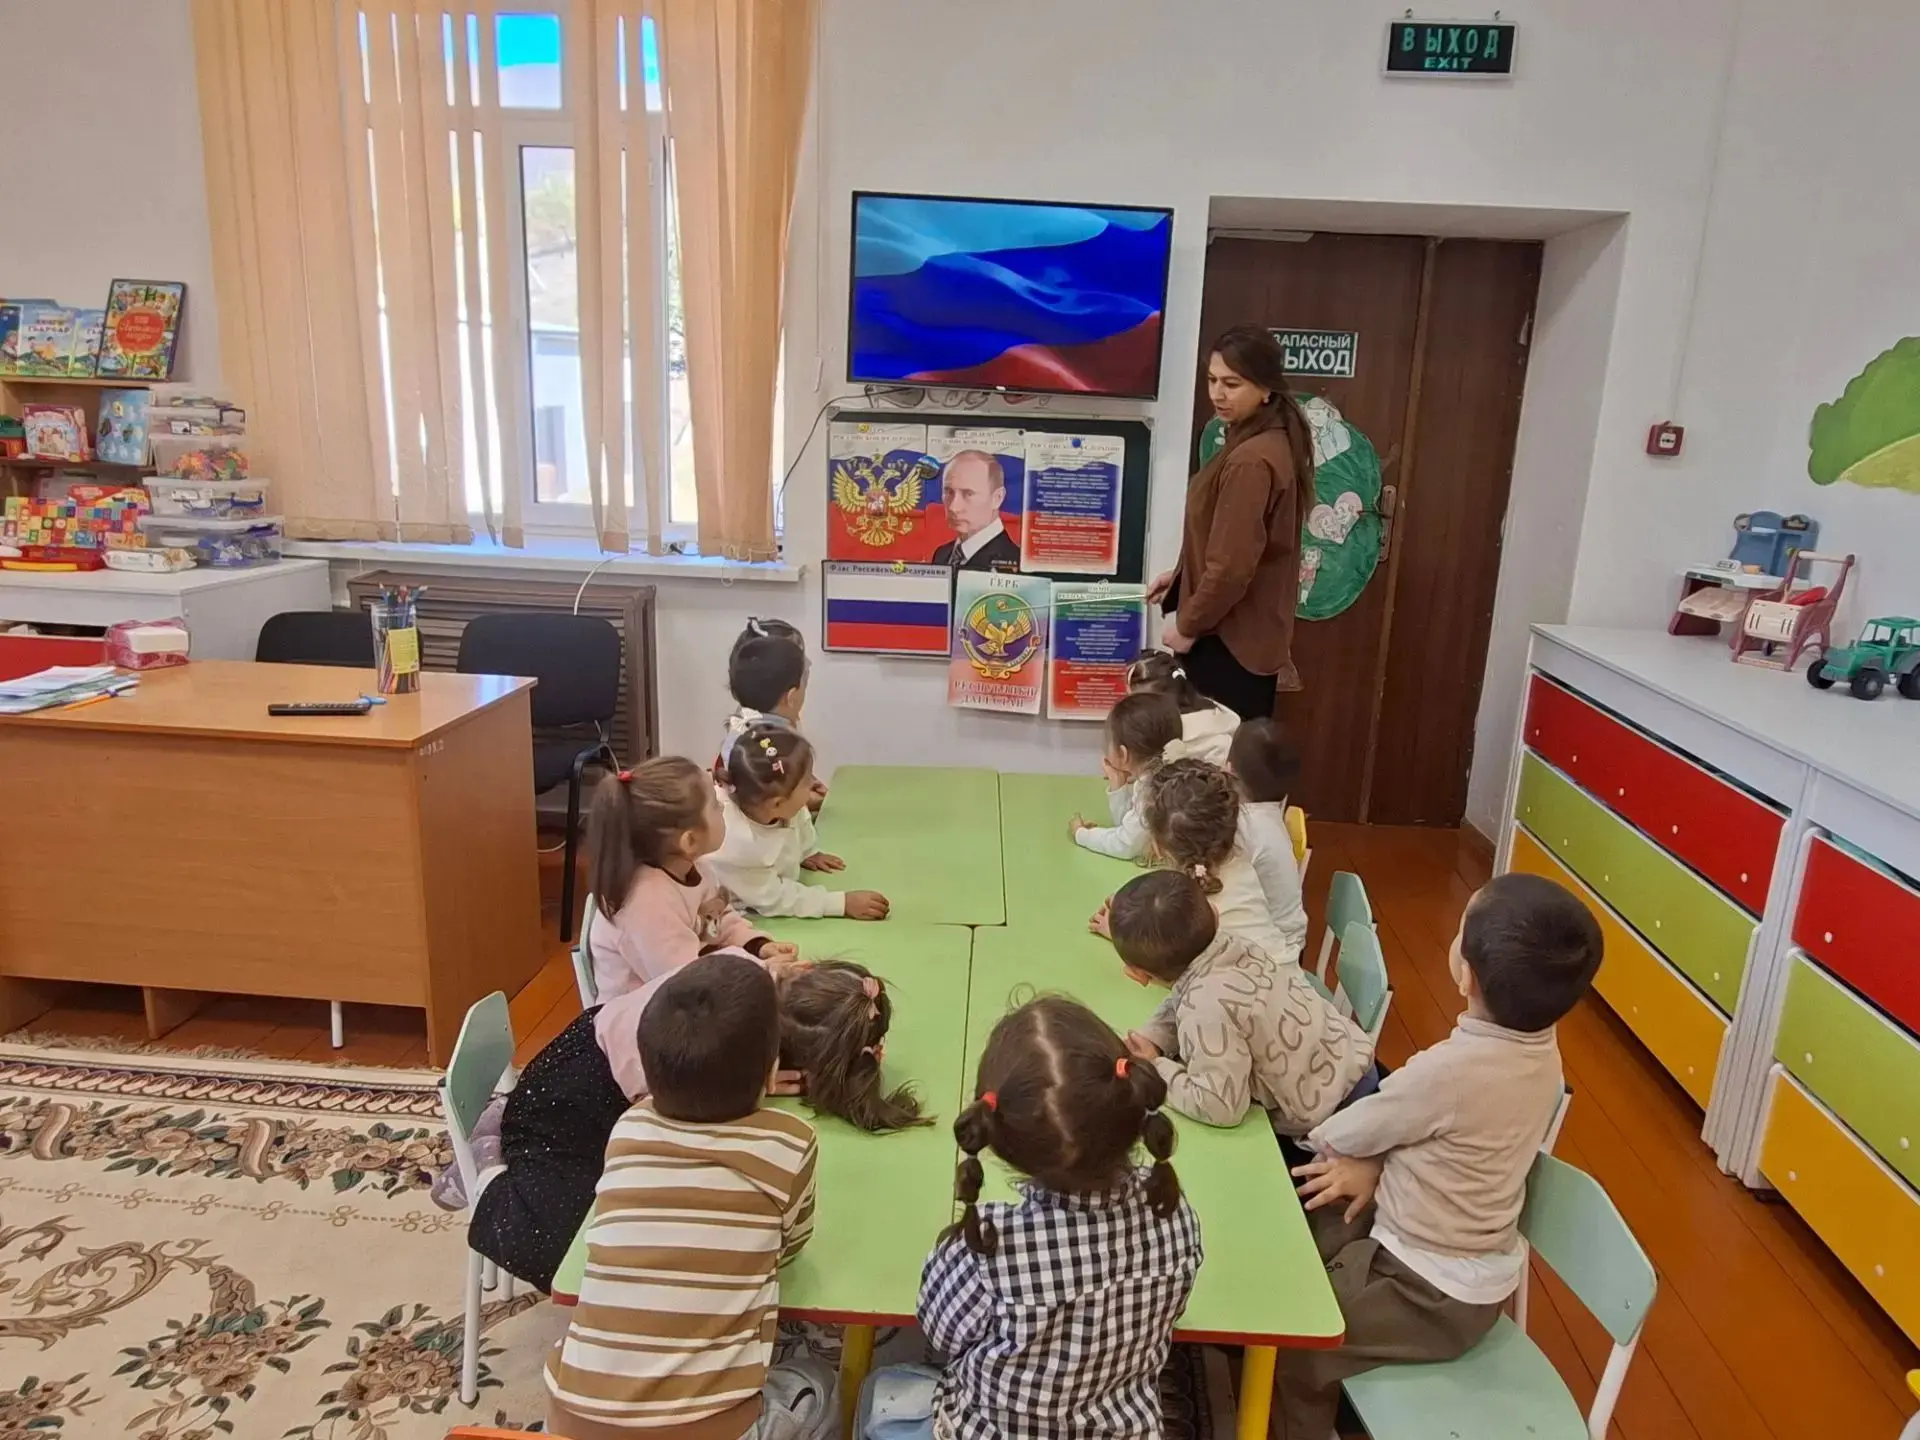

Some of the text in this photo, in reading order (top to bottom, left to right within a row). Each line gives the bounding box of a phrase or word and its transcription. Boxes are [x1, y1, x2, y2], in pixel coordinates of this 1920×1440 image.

[1402, 27, 1500, 59] ВЫХОД
[1424, 56, 1473, 69] EXIT
[1281, 348, 1351, 375] ЫХОД
[990, 577, 1020, 588] ГЕРБ
